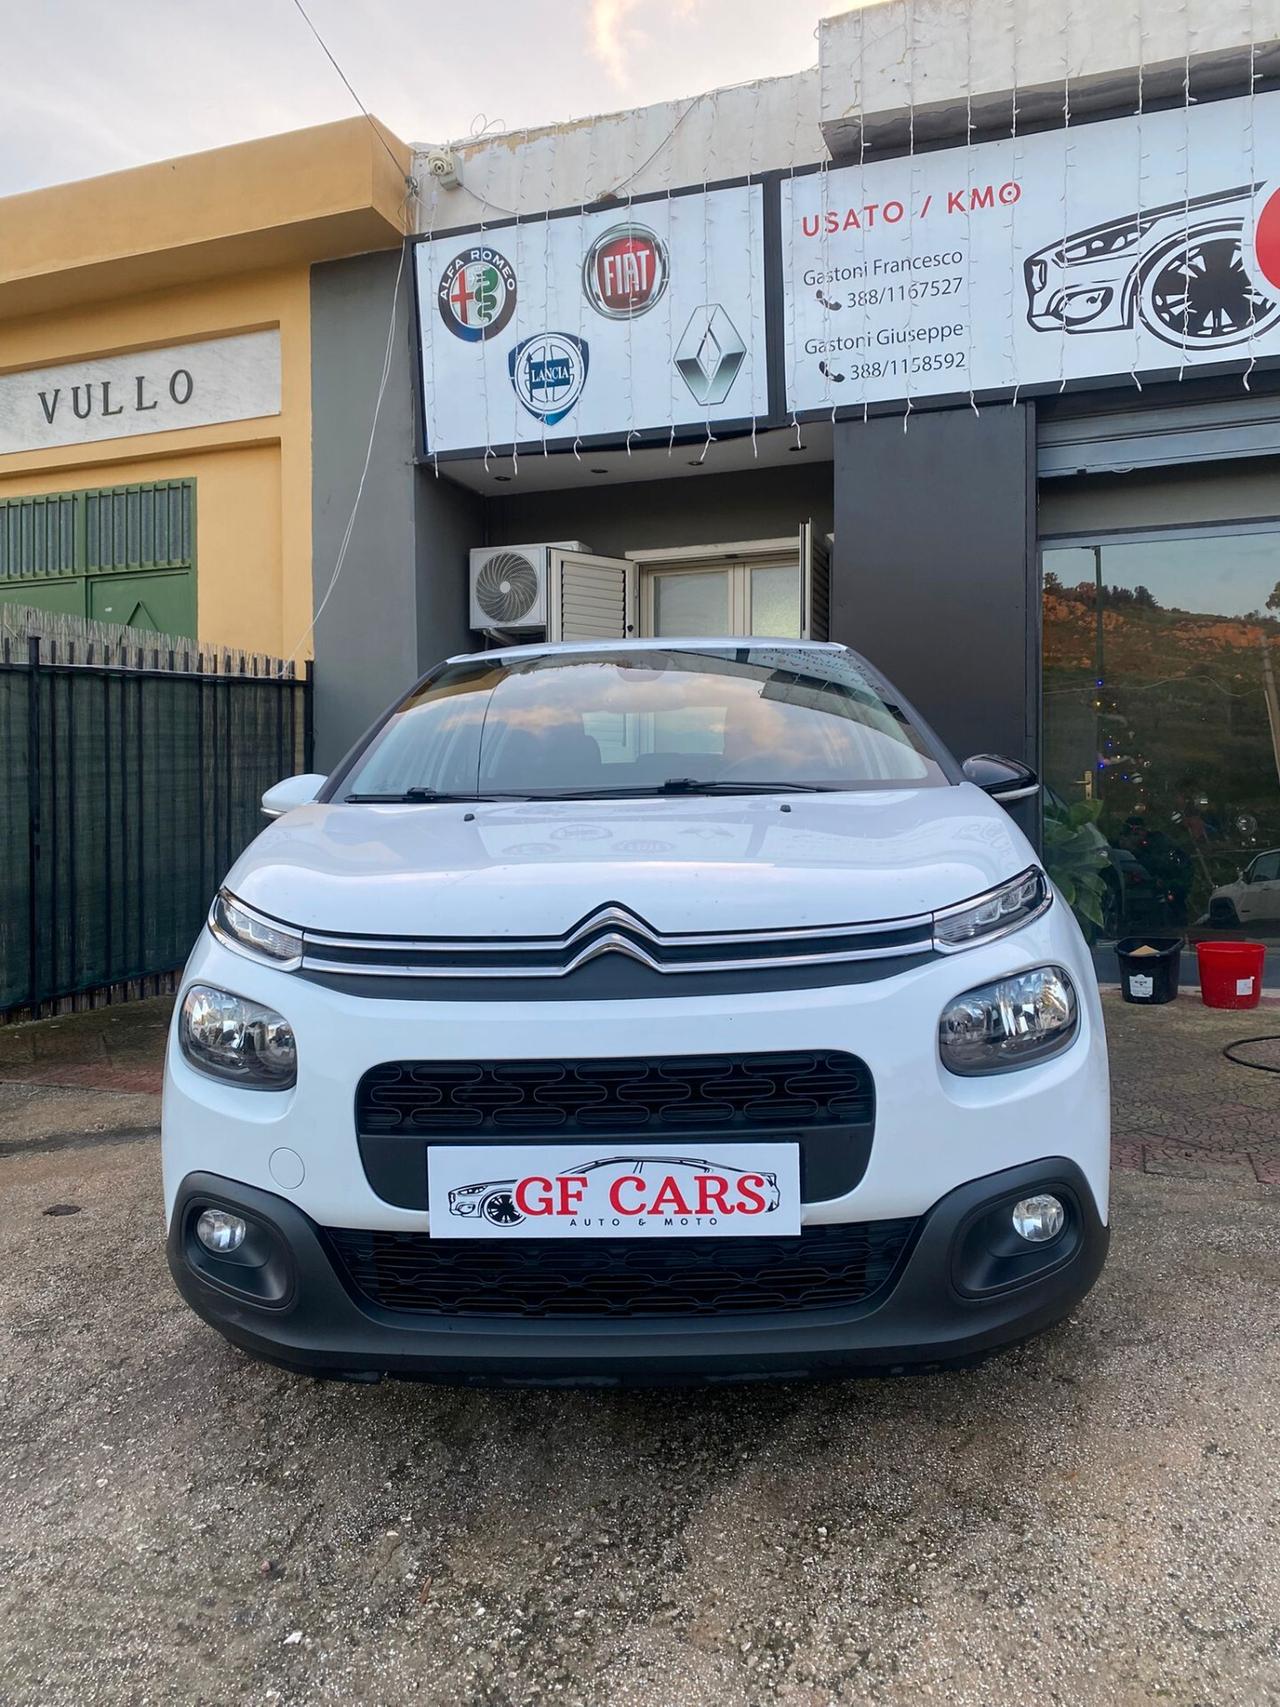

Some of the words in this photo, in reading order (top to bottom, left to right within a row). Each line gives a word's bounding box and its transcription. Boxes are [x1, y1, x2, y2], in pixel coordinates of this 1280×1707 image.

[802, 200, 904, 237] USATO
[920, 195, 932, 219] /
[439, 258, 464, 300] ALFA
[470, 250, 516, 292] ROMEO
[603, 249, 651, 297] FIAT
[803, 261, 868, 286] Gastoni
[873, 251, 963, 276] Francesco
[847, 277, 963, 308] 388/1167527
[804, 332, 871, 355] Gastoni
[876, 323, 964, 345] Giuseppe
[531, 365, 570, 383] LANCIA
[850, 352, 966, 381] 388/1158592
[38, 369, 194, 424] VULLO
[515, 1176, 589, 1216] GF
[609, 1175, 767, 1215] CARS
[569, 1218, 621, 1227] AUTO
[638, 1218, 647, 1227] &
[664, 1217, 719, 1227] MOTO
